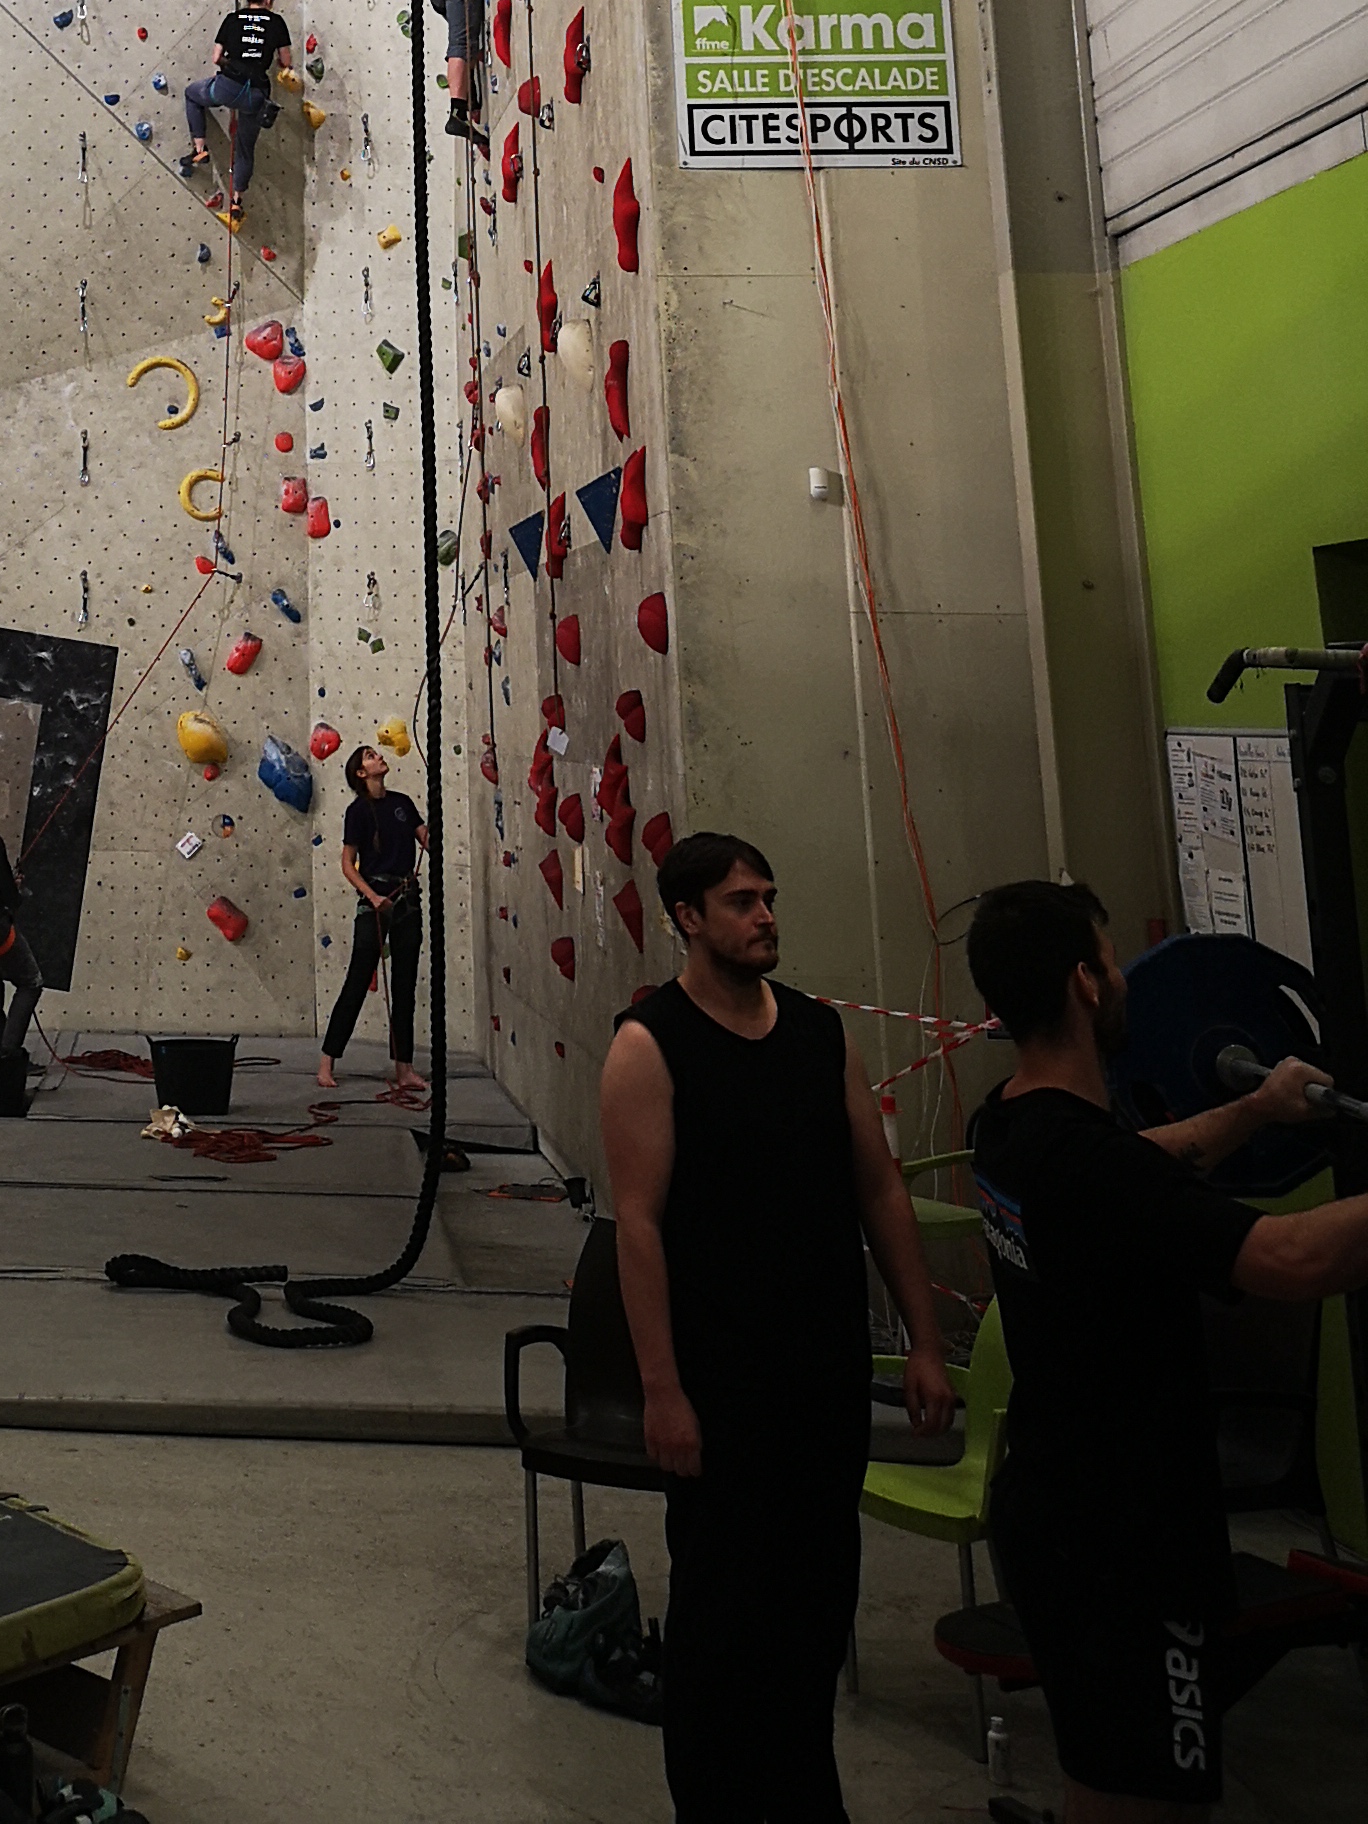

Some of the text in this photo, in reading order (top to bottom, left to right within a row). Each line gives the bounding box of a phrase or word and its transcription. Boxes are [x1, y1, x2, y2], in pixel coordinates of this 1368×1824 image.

[739, 4, 937, 51] Karma
[695, 38, 730, 50] ffme
[697, 67, 940, 94] SALLE D'ESCALADE
